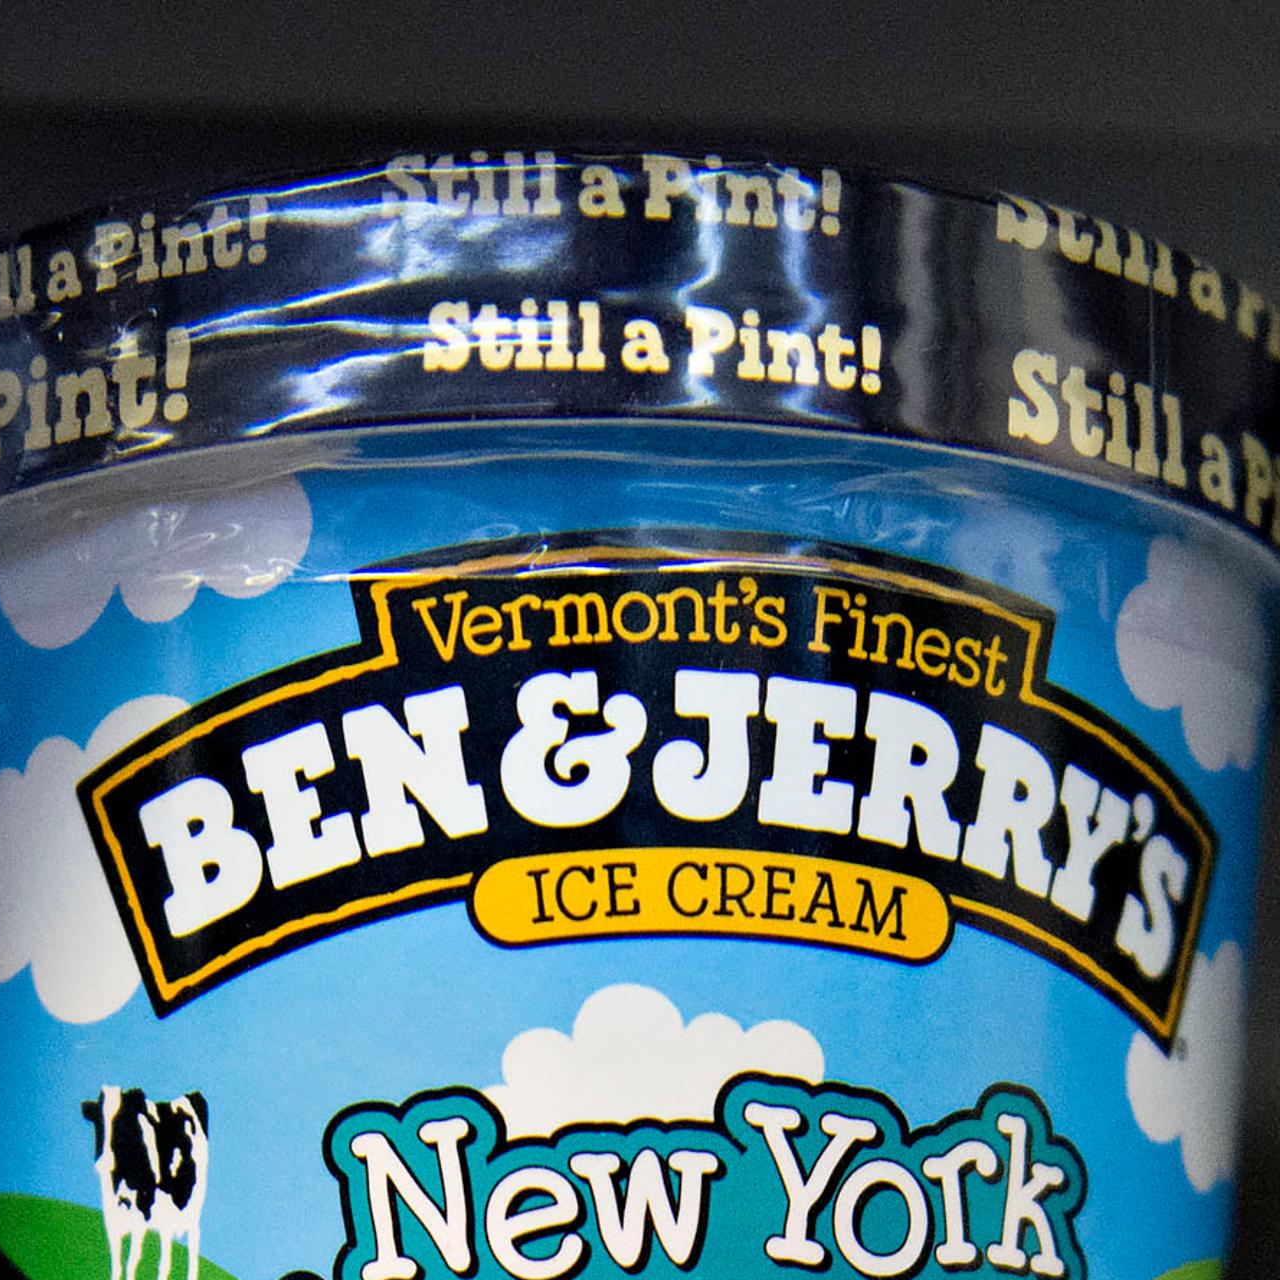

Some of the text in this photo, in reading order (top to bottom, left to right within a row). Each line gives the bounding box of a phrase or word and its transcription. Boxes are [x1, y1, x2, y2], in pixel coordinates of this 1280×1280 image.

[46, 249, 84, 304] a
[92, 194, 269, 294] Pint!
[380, 150, 843, 237] Still a Pint!
[422, 298, 882, 395] Still a Pint!
[1007, 348, 1188, 489] Still
[1199, 432, 1235, 510] a
[411, 577, 1011, 699] Vermont's Finest
[138, 667, 1190, 982] BEN & JERRY'S
[526, 861, 909, 941] ICE CREAM
[744, 1102, 1066, 1280] York
